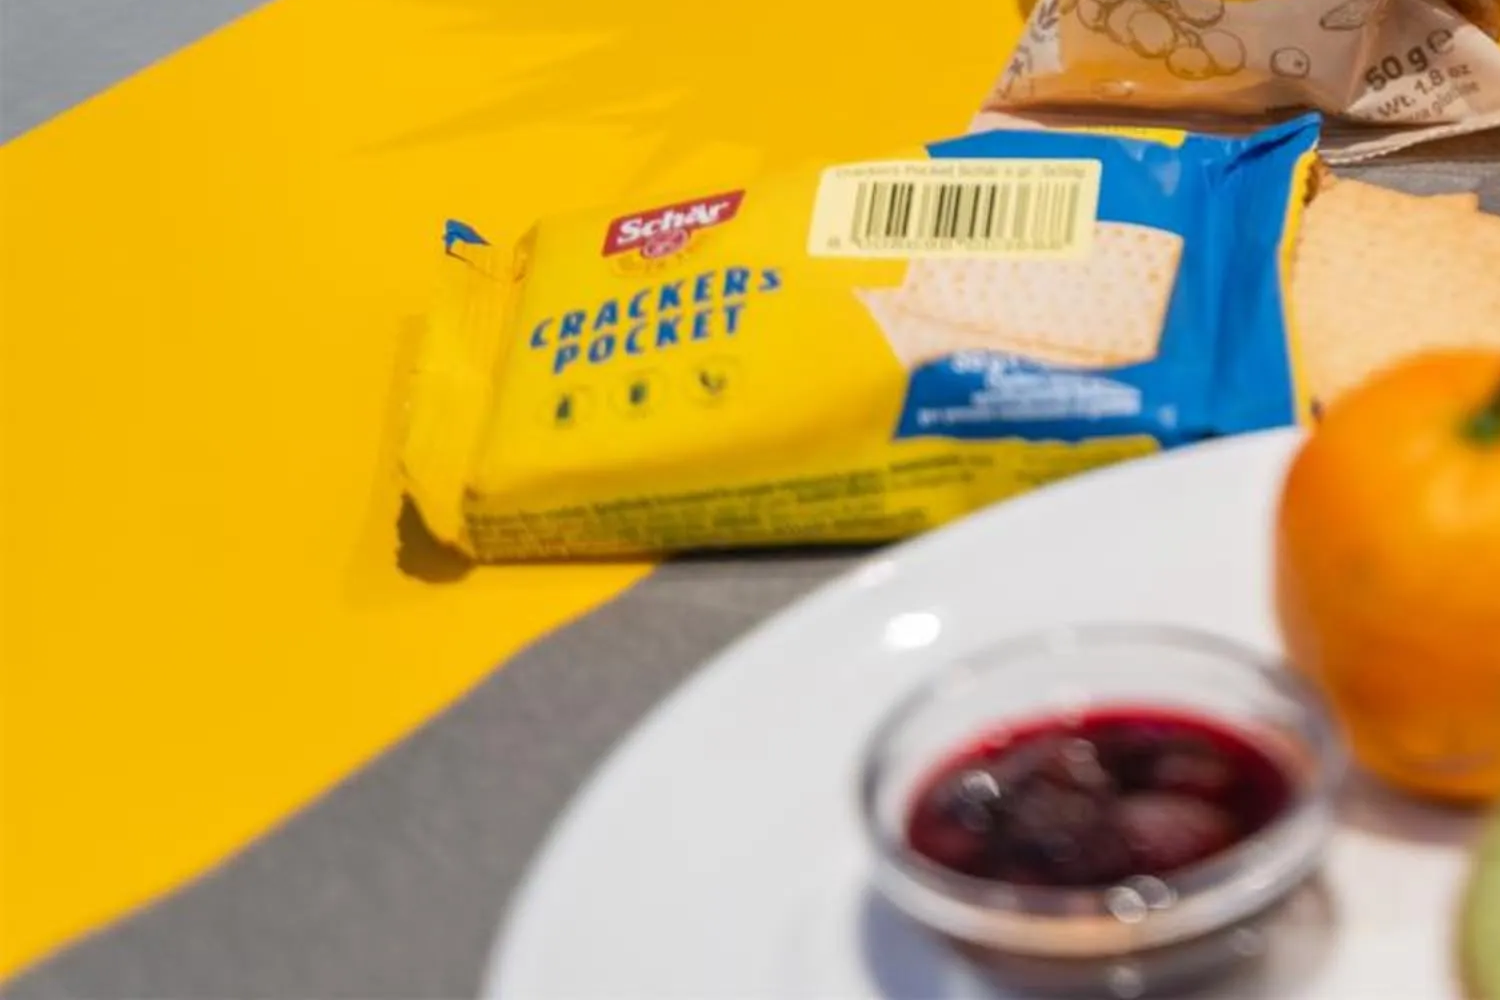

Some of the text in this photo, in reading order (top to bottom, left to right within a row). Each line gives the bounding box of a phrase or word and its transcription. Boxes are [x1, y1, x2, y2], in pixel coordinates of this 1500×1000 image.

[1365, 55, 1403, 92] 50
[1407, 45, 1428, 73] g
[615, 201, 730, 246] Schär
[553, 302, 745, 375] POCKET
